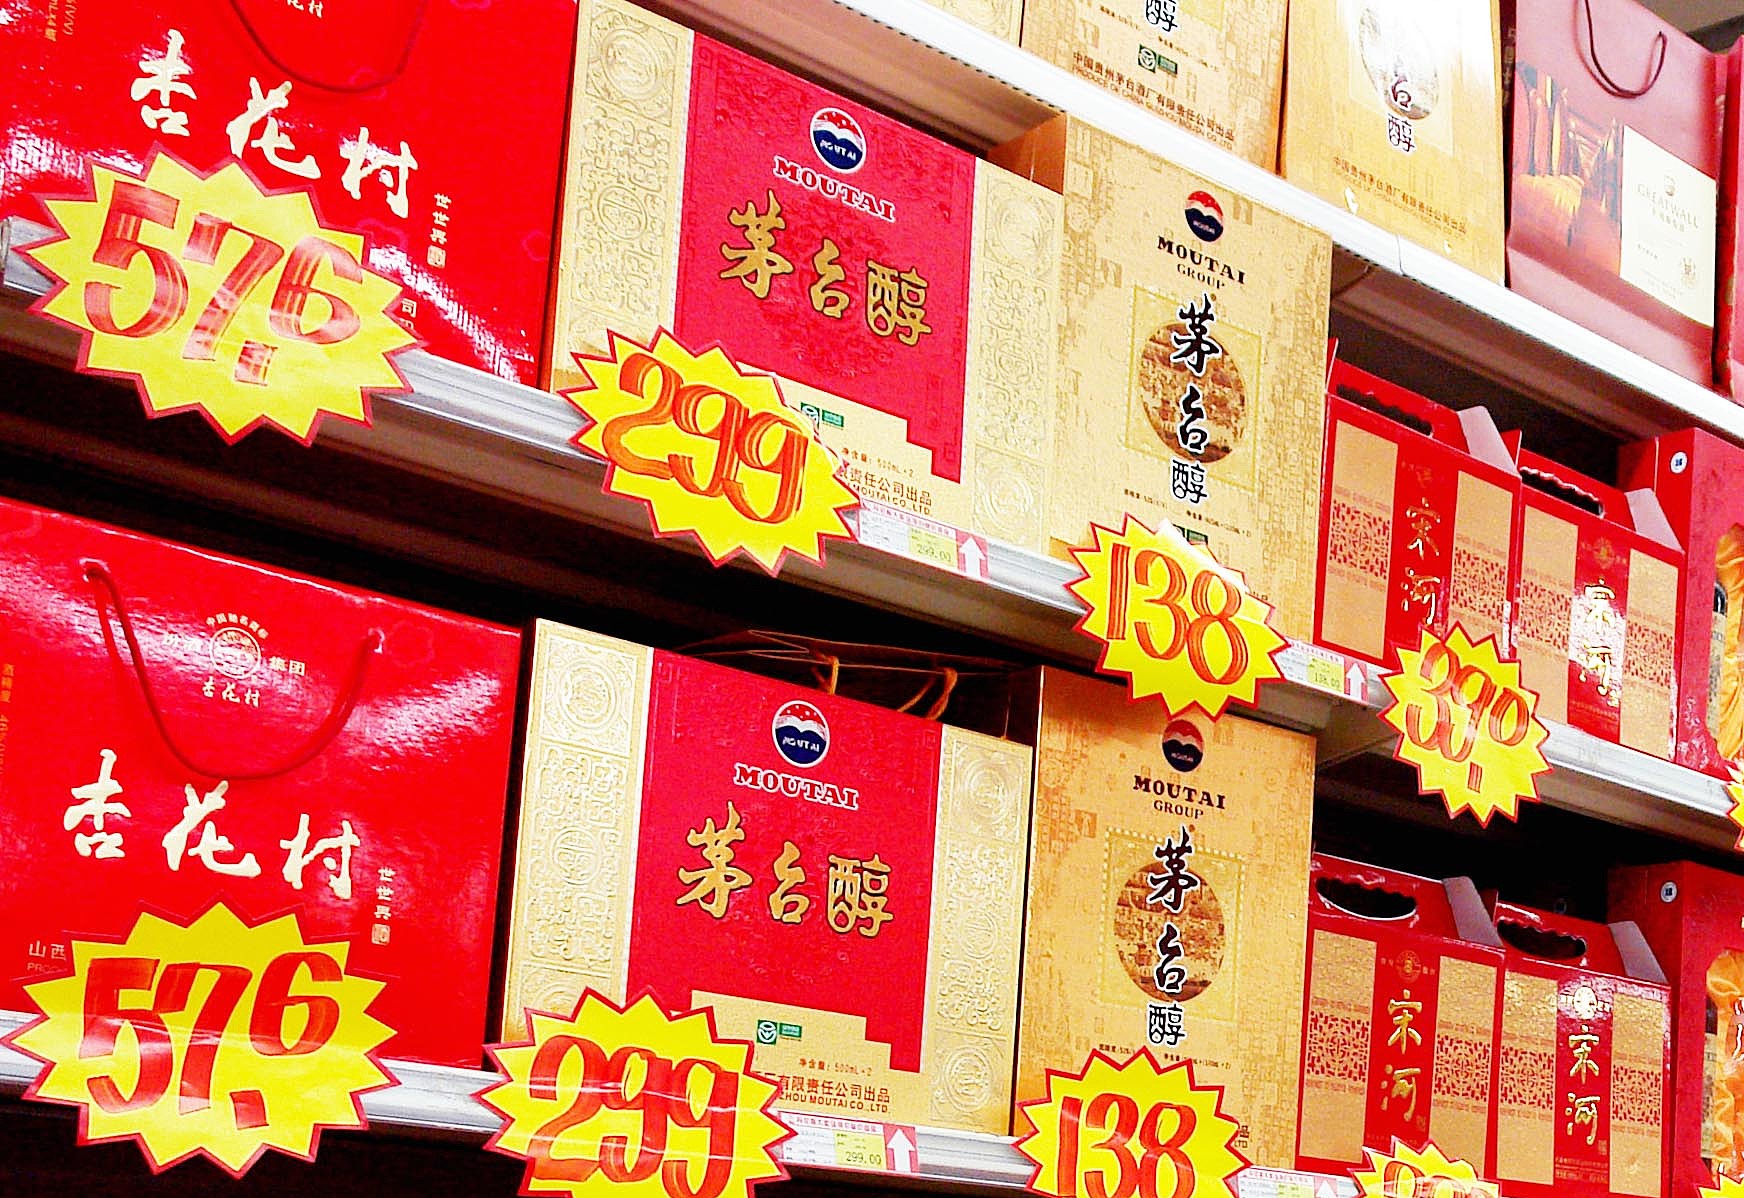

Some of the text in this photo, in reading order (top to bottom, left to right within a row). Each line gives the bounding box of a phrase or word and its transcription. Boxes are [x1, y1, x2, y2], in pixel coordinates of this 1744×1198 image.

[131, 28, 418, 218] 杏花村
[773, 155, 896, 222] MOUTAI
[718, 189, 933, 348] 茅台醇
[1157, 235, 1247, 285] MOUTAI
[1176, 263, 1226, 289] GROUP
[602, 352, 809, 524] 299
[1169, 291, 1222, 505] 茅台醇
[1106, 542, 1250, 686] 138
[202, 676, 261, 708] 杏花村
[64, 748, 361, 899] 杏花村
[732, 761, 860, 811] MOUTAI
[1132, 774, 1227, 810] MOUTAI
[1152, 799, 1204, 821] GROUP
[676, 800, 895, 938] 茅台醇
[1145, 826, 1200, 1048] 茅台醇
[809, 1093, 848, 1109] MOUTAI
[1381, 988, 1423, 1122] 宋河
[1565, 1024, 1602, 1146] 宋河
[844, 1150, 883, 1166] 299.00
